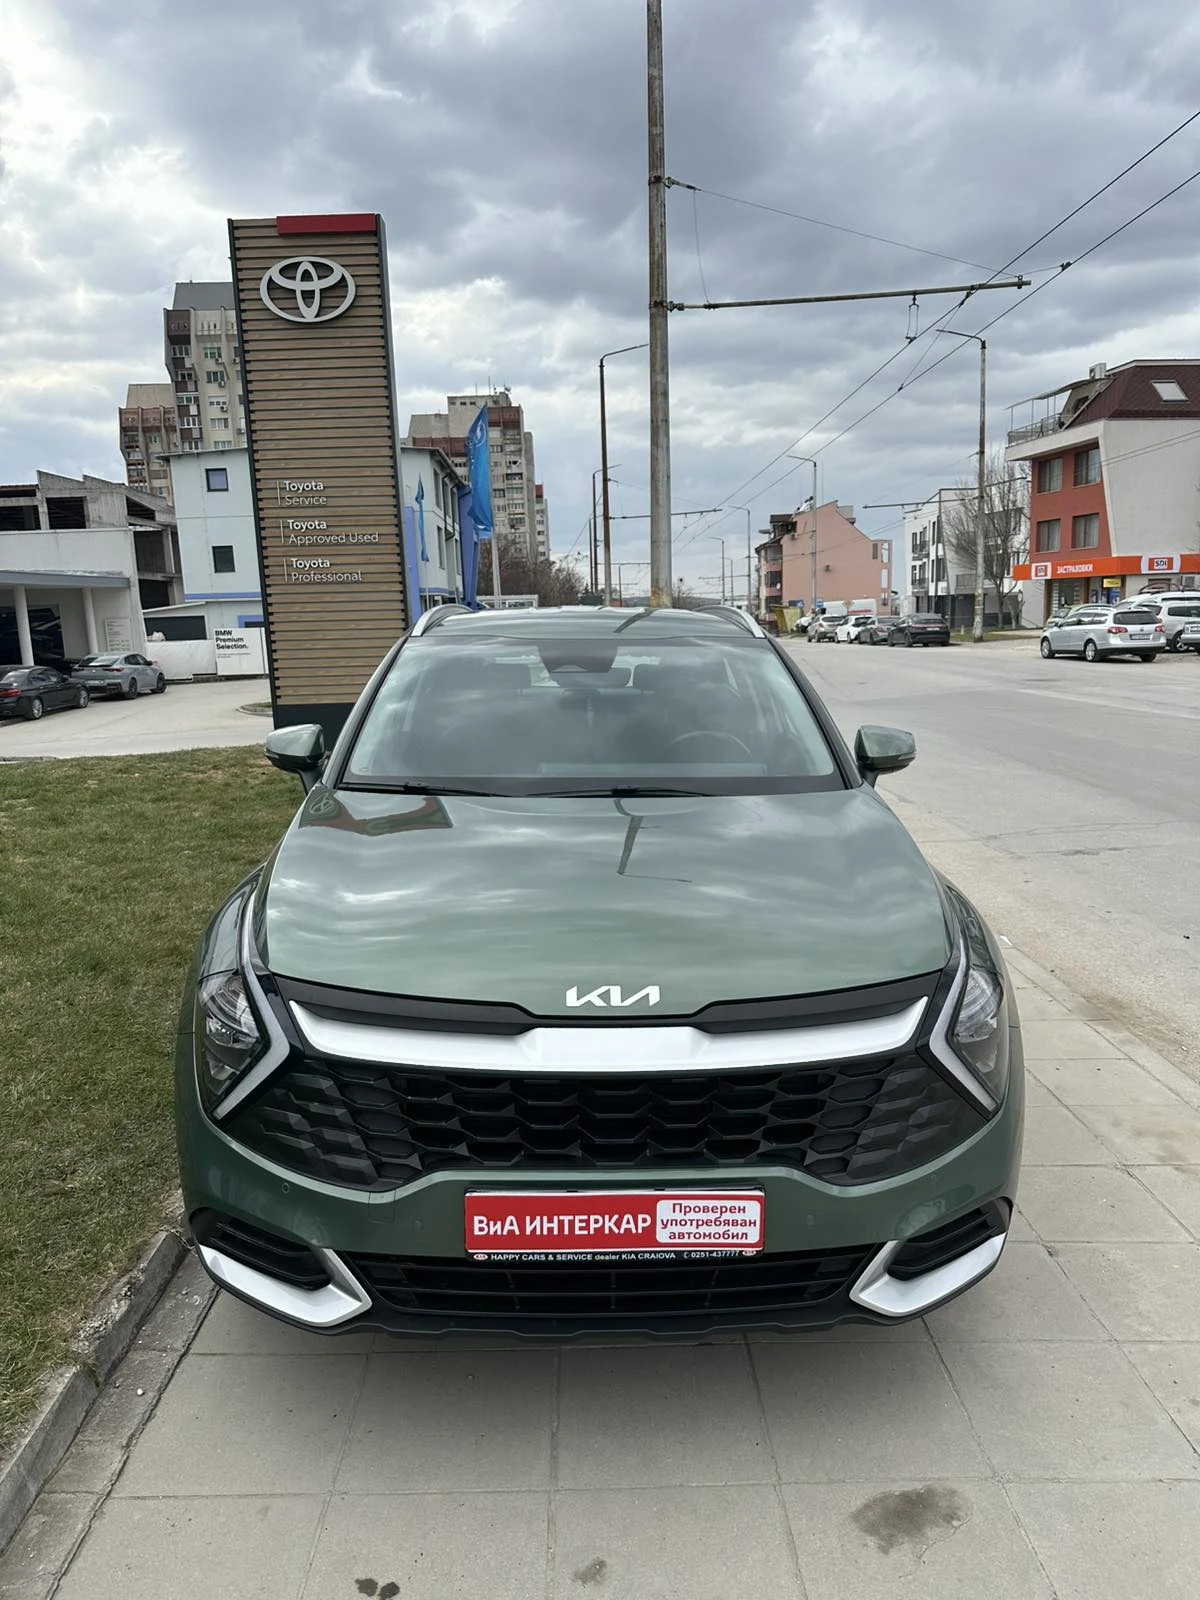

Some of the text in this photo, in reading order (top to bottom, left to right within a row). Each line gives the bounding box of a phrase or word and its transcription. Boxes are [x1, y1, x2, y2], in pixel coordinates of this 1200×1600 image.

[284, 481, 324, 493] Toyota
[285, 495, 327, 505] Service
[287, 520, 327, 532] Toyota
[289, 531, 379, 546] Approved Used
[291, 558, 330, 570] Toyota
[291, 570, 362, 582] Professional
[566, 985, 660, 1007] KIA
[672, 1203, 746, 1216] Проверен
[473, 1213, 652, 1236] ВиА ИНТЕРКАР
[661, 1216, 757, 1229] употребяван
[668, 1229, 749, 1241] автомобил
[490, 1253, 521, 1261] HAPPY
[522, 1253, 546, 1261] CARS
[547, 1253, 555, 1261] &
[556, 1253, 593, 1261] SERVICE
[594, 1252, 621, 1261] dealer
[621, 1252, 637, 1261] KIA
[637, 1252, 677, 1260] CRAIOVA
